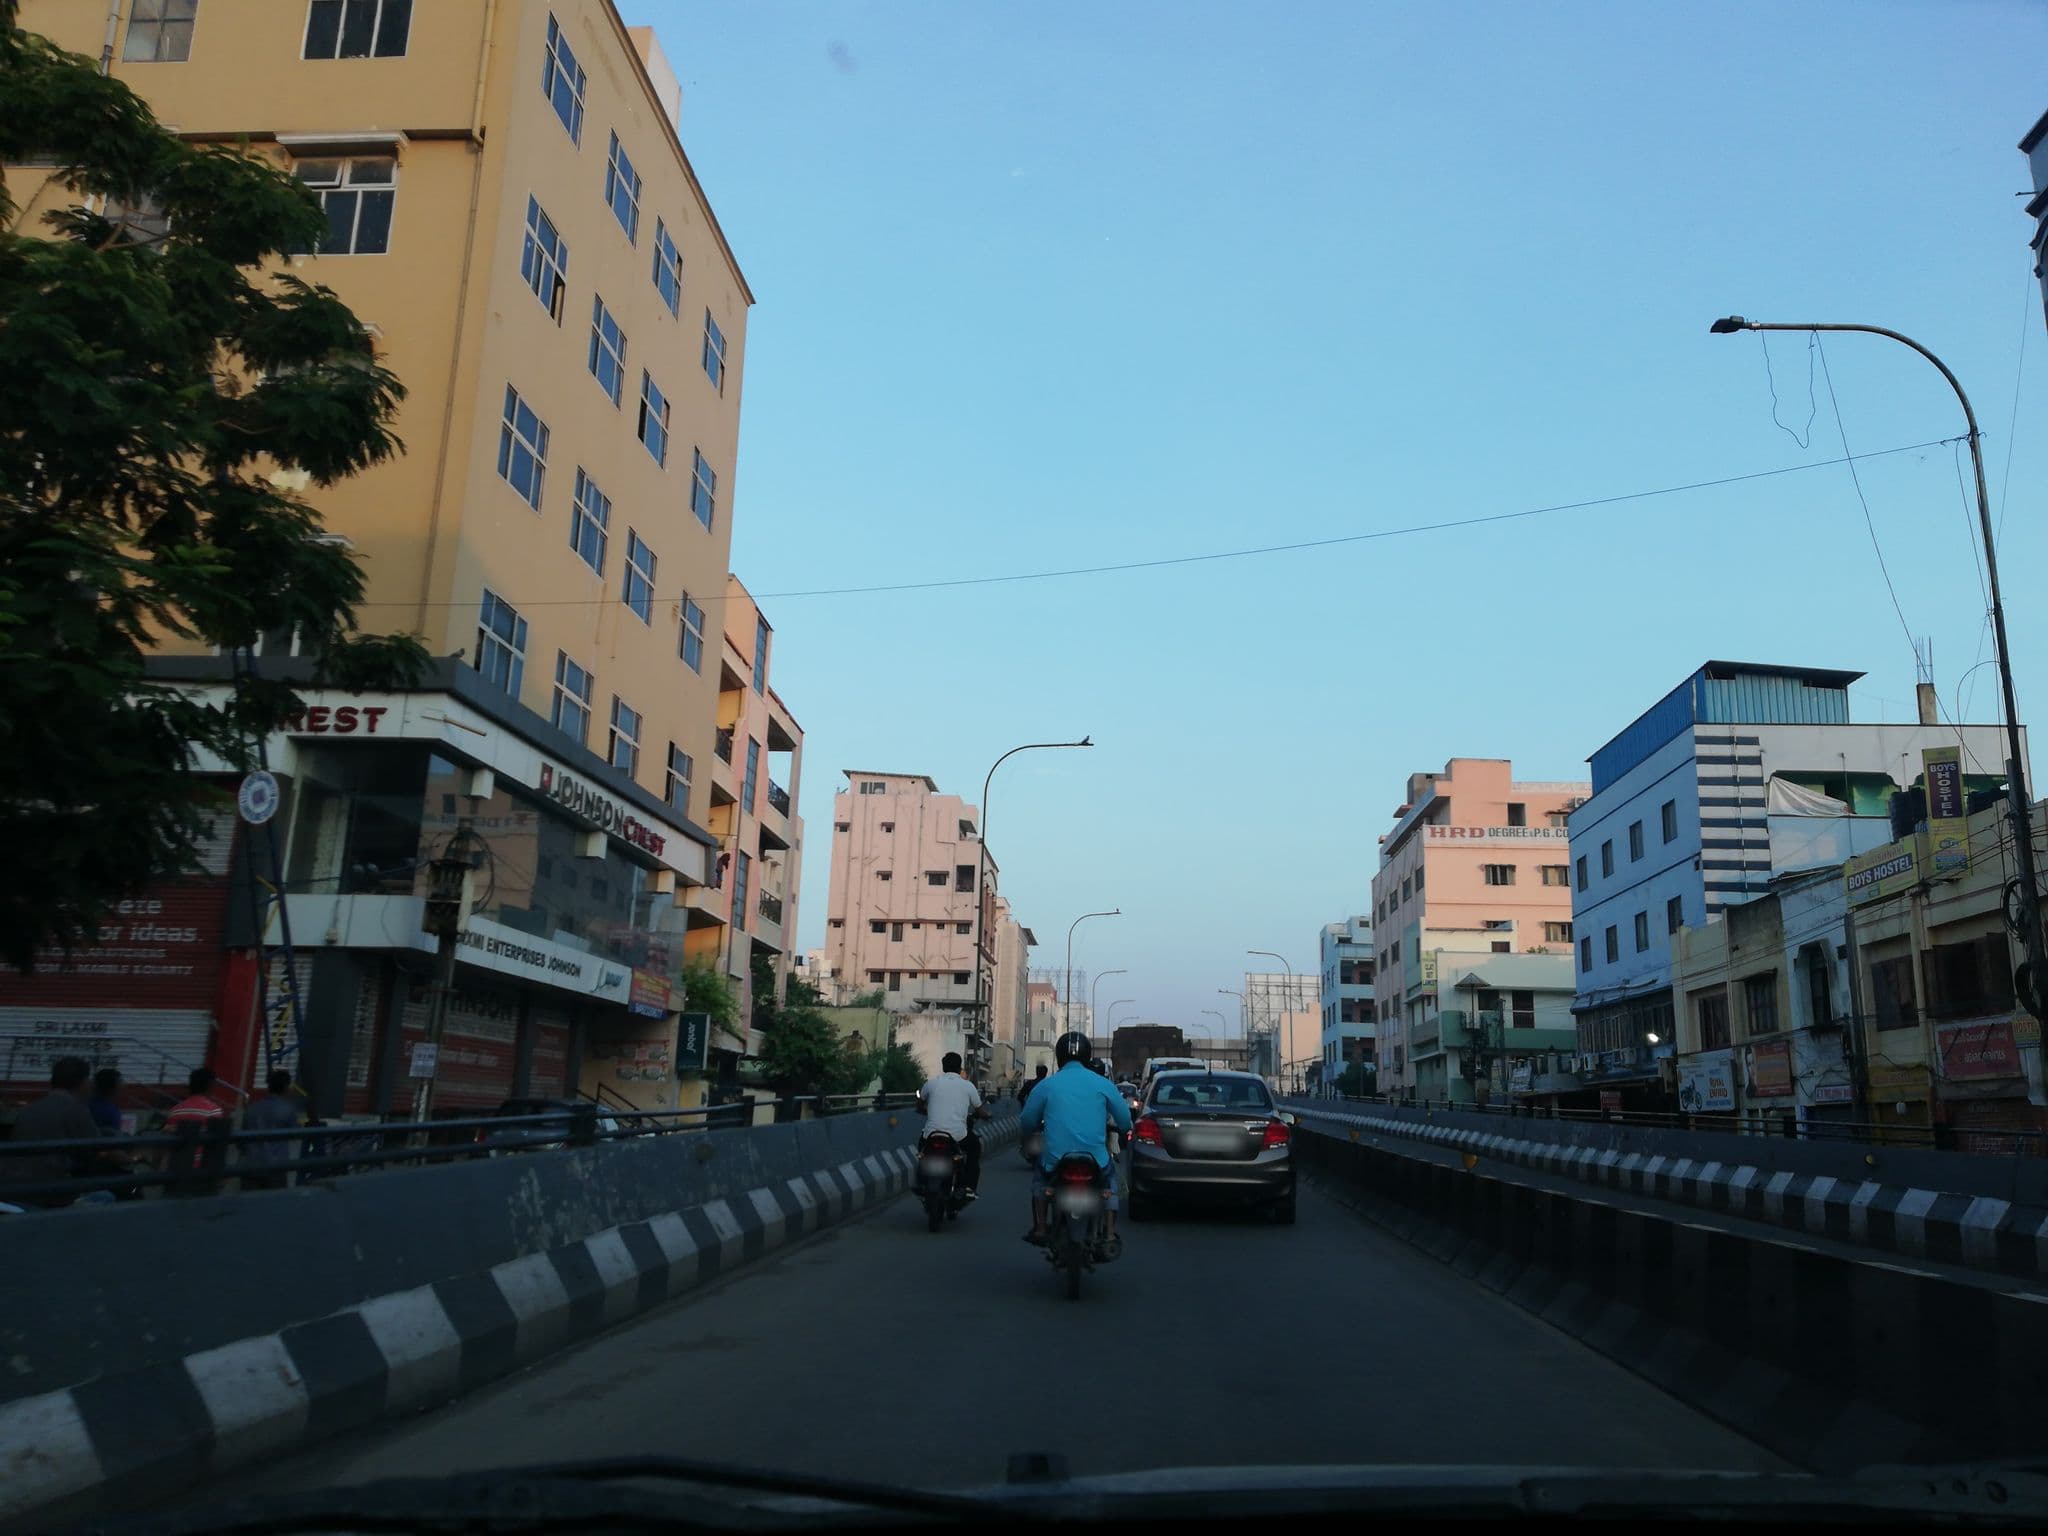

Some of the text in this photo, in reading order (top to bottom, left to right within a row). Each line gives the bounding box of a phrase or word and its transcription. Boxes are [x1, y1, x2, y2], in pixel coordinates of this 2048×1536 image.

[279, 705, 388, 732] REST
[1929, 763, 1957, 773] BOYS
[1936, 771, 1953, 817] HOSTEL
[1429, 827, 1486, 838] HRD
[1488, 827, 1528, 838] DEGREE
[1556, 828, 1568, 838] CO
[1848, 870, 1872, 890] BOYS
[1873, 856, 1913, 881] HOSTEL
[486, 937, 546, 968] ENTERPRISES
[547, 954, 582, 978] JOHNSON
